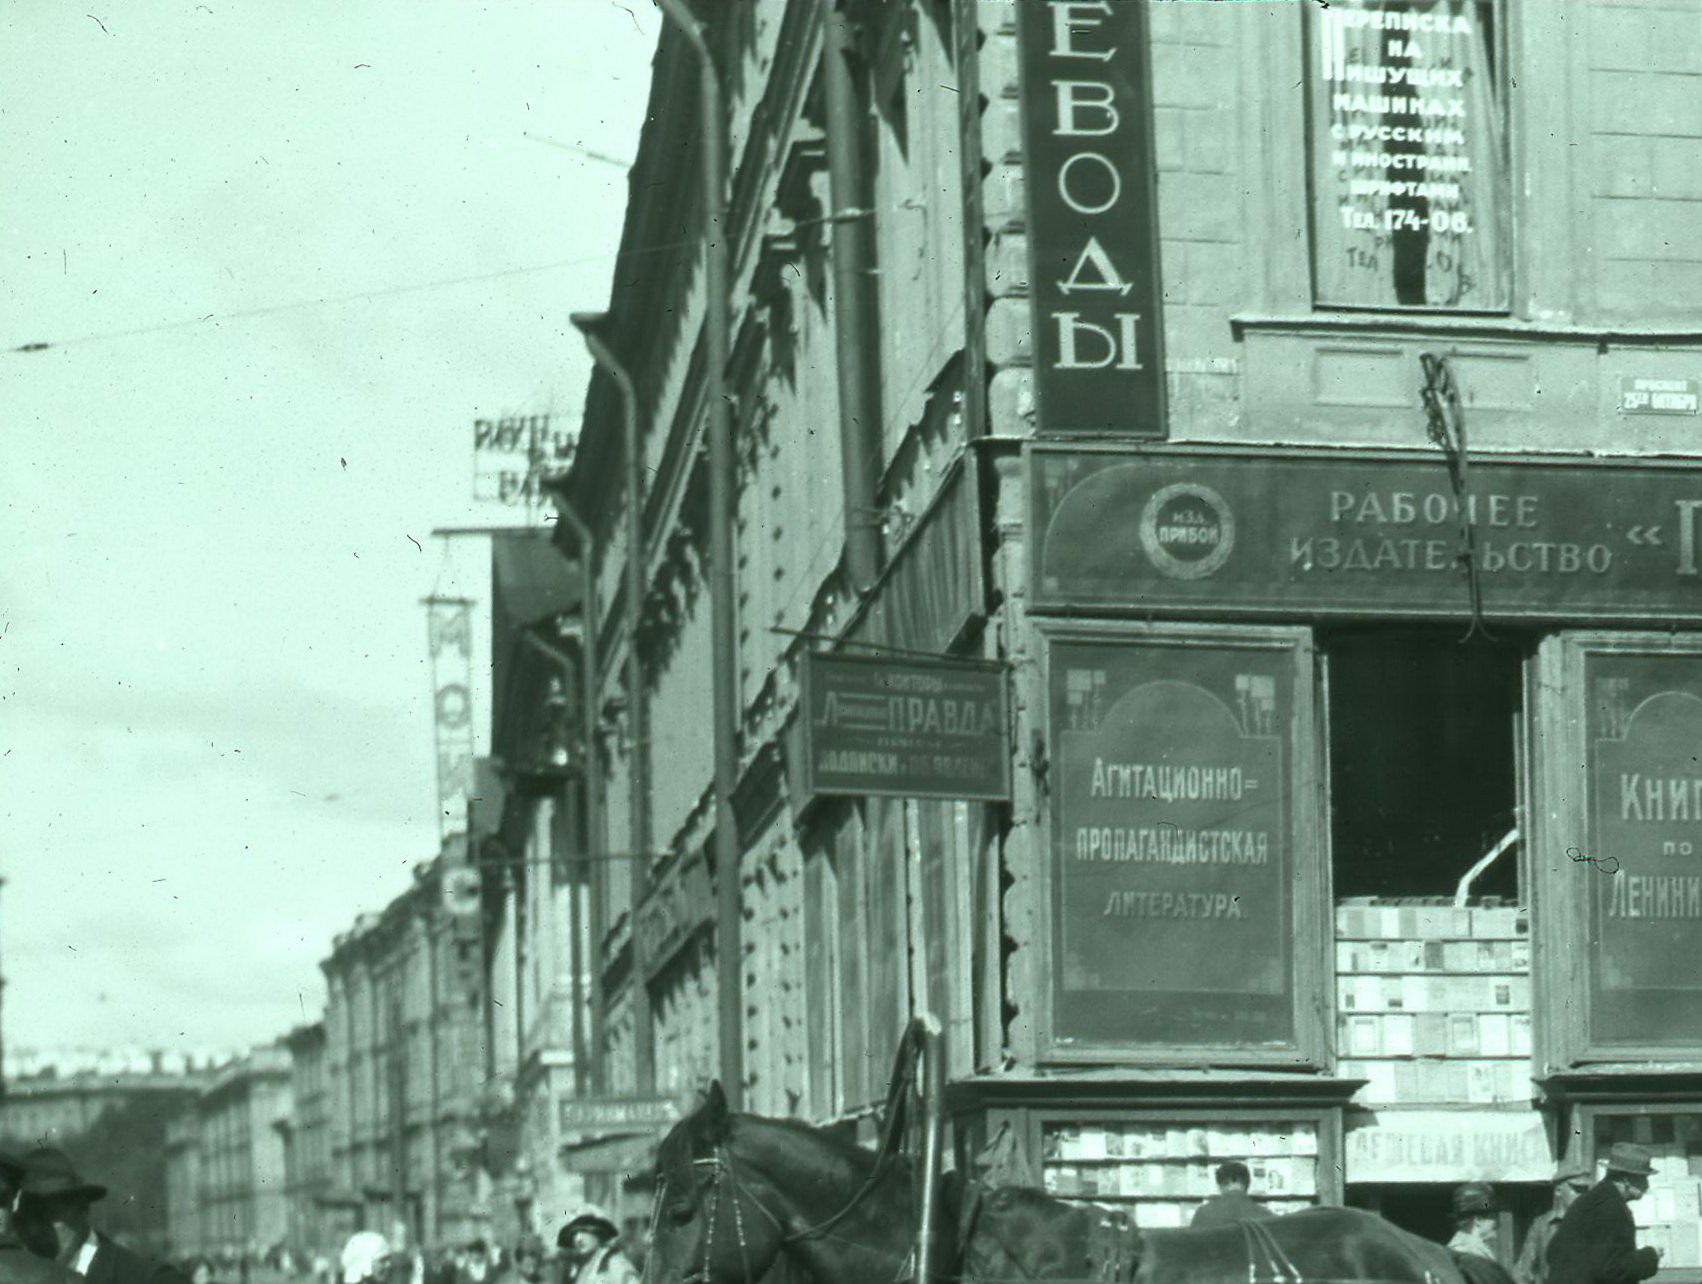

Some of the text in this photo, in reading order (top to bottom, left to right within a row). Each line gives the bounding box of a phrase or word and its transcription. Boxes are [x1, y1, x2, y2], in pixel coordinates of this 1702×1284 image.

[1387, 40, 1422, 58] НА
[1333, 94, 1465, 117] МАШИНАХ
[1158, 524, 1219, 545] ПРИБОЙ
[1289, 539, 1612, 574] ИЗДАТЕЬСТВО
[887, 696, 995, 737] ПРАВДА
[1076, 828, 1268, 865] ПРОПАГАНДИСТСКАЯ
